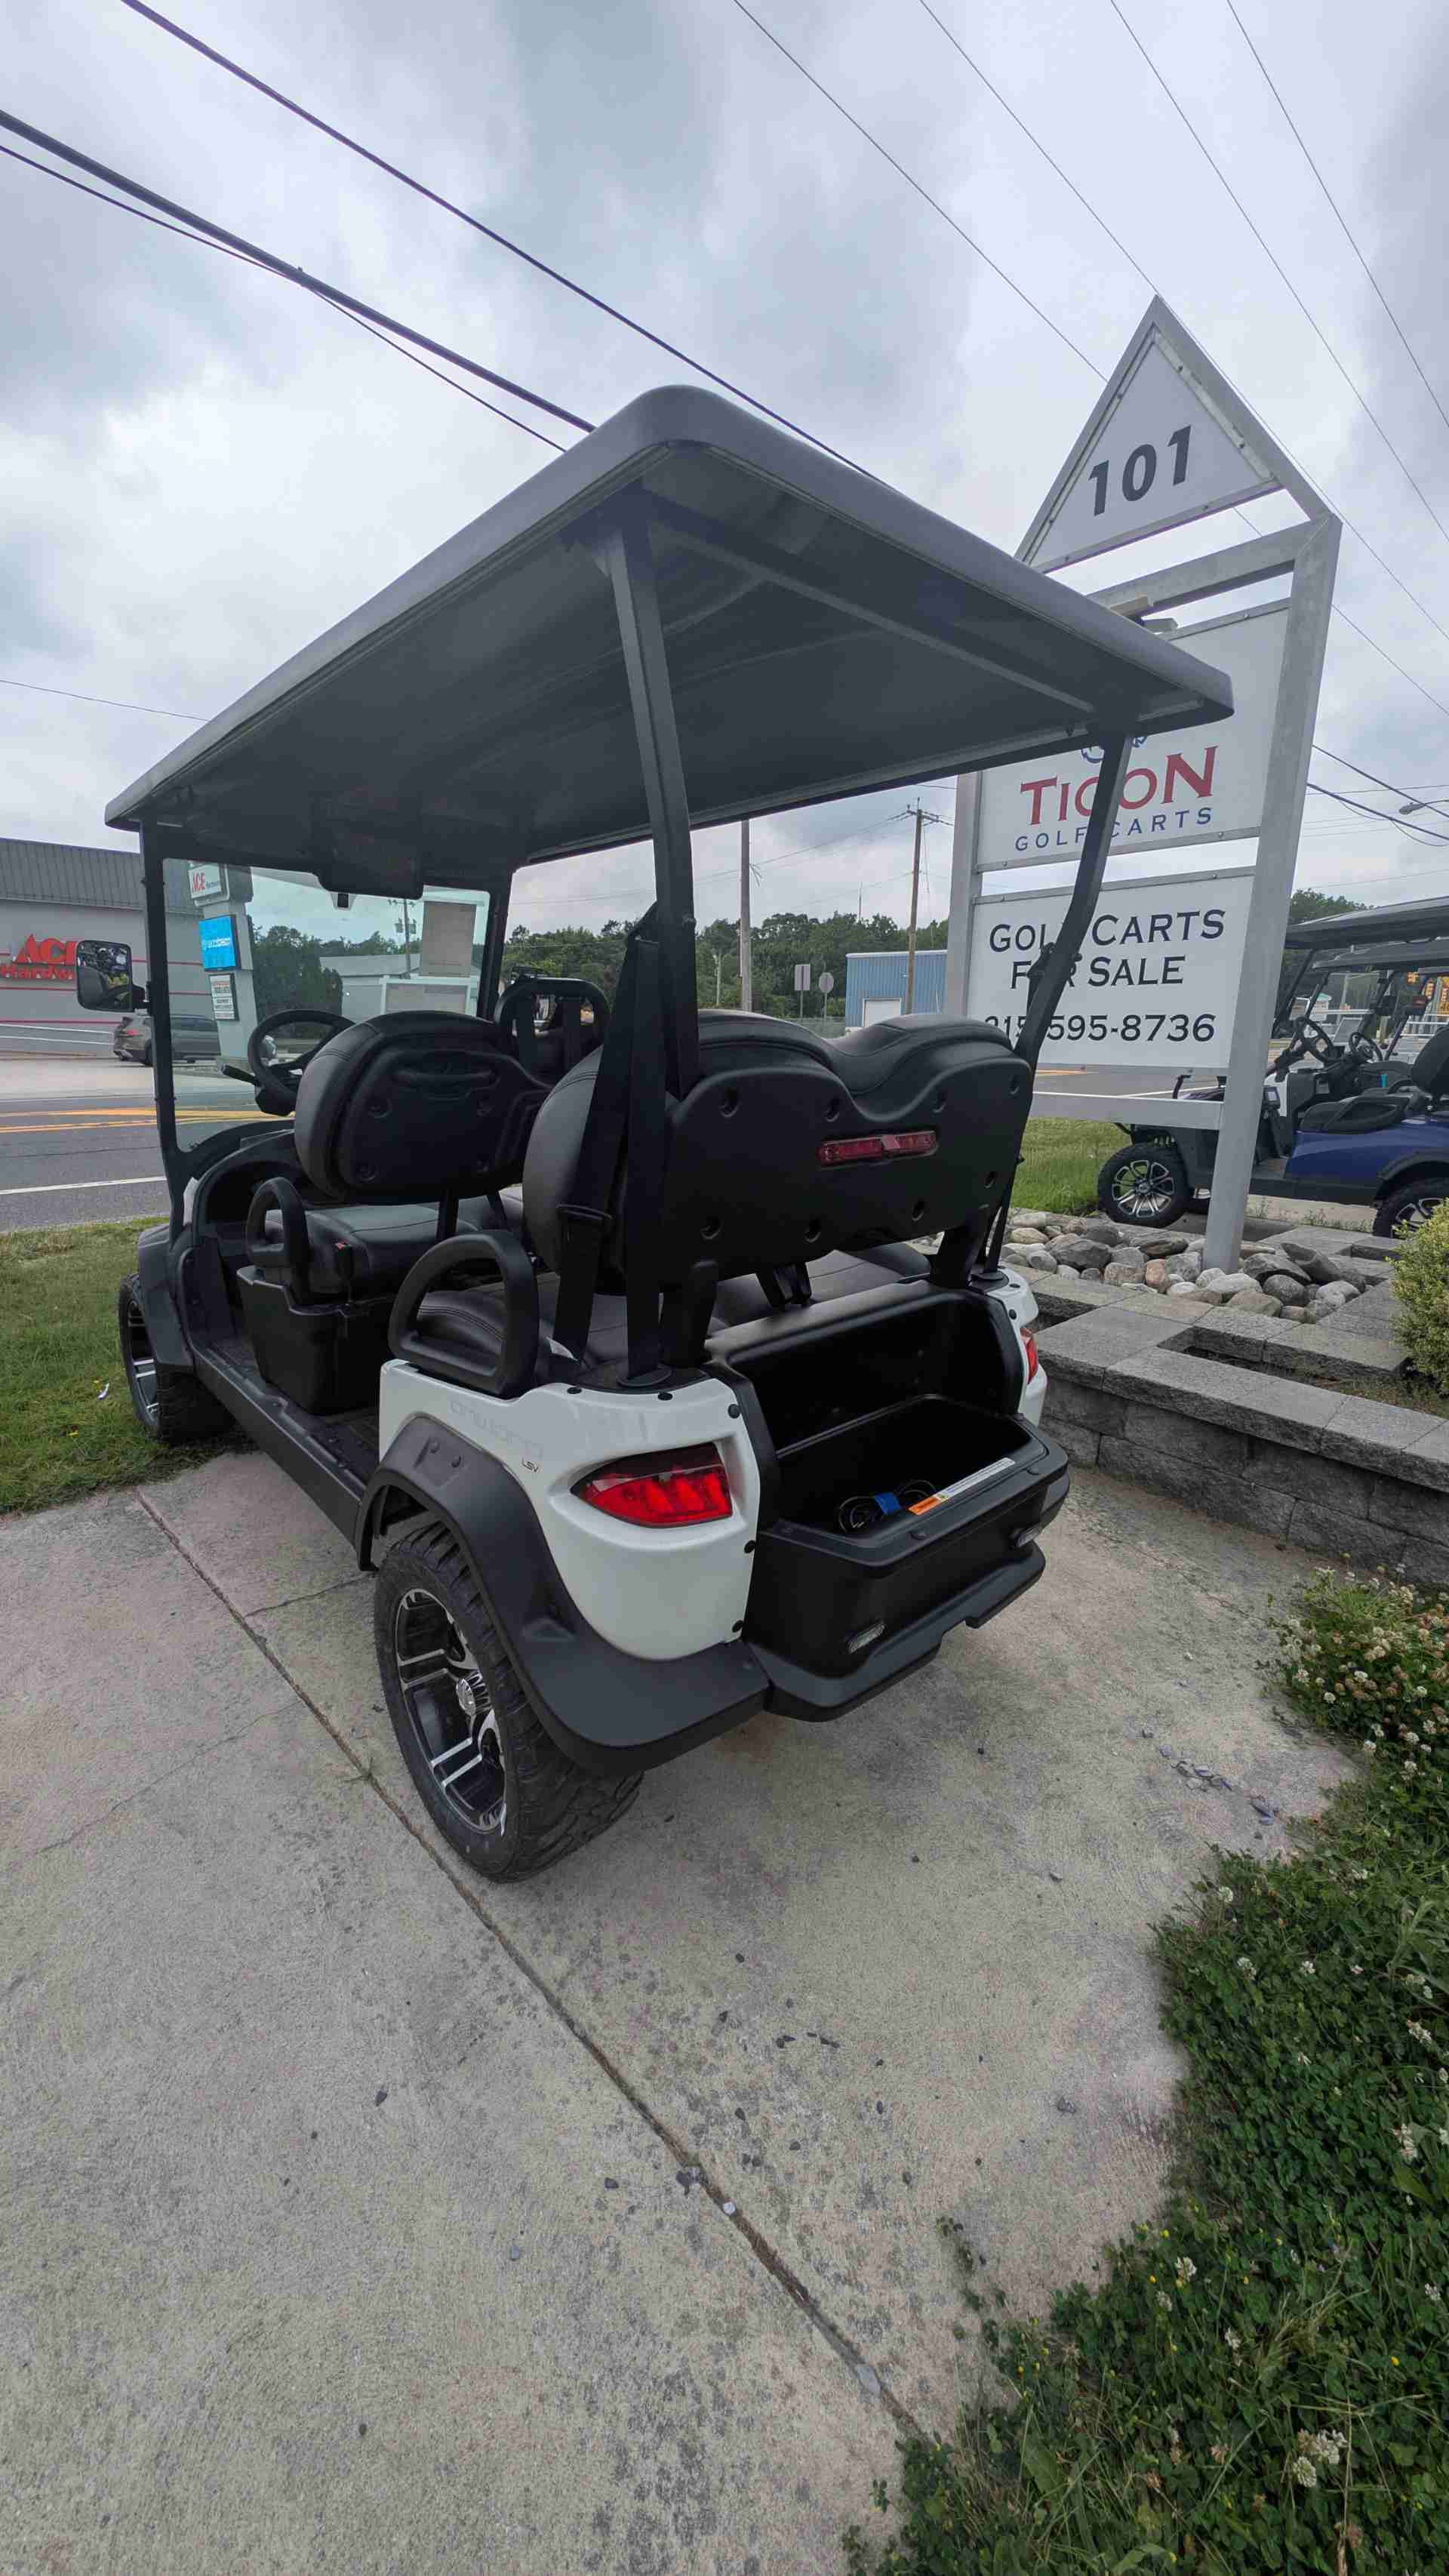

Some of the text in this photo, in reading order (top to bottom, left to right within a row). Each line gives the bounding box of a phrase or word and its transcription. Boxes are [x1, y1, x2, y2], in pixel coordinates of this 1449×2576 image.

[1088, 424, 1191, 516] 101
[1014, 807, 1213, 851] GOLF CARTS
[989, 909, 1226, 953] GOL CARTS
[1010, 955, 1186, 989] FR SALE
[521, 1457, 539, 1473] LSV
